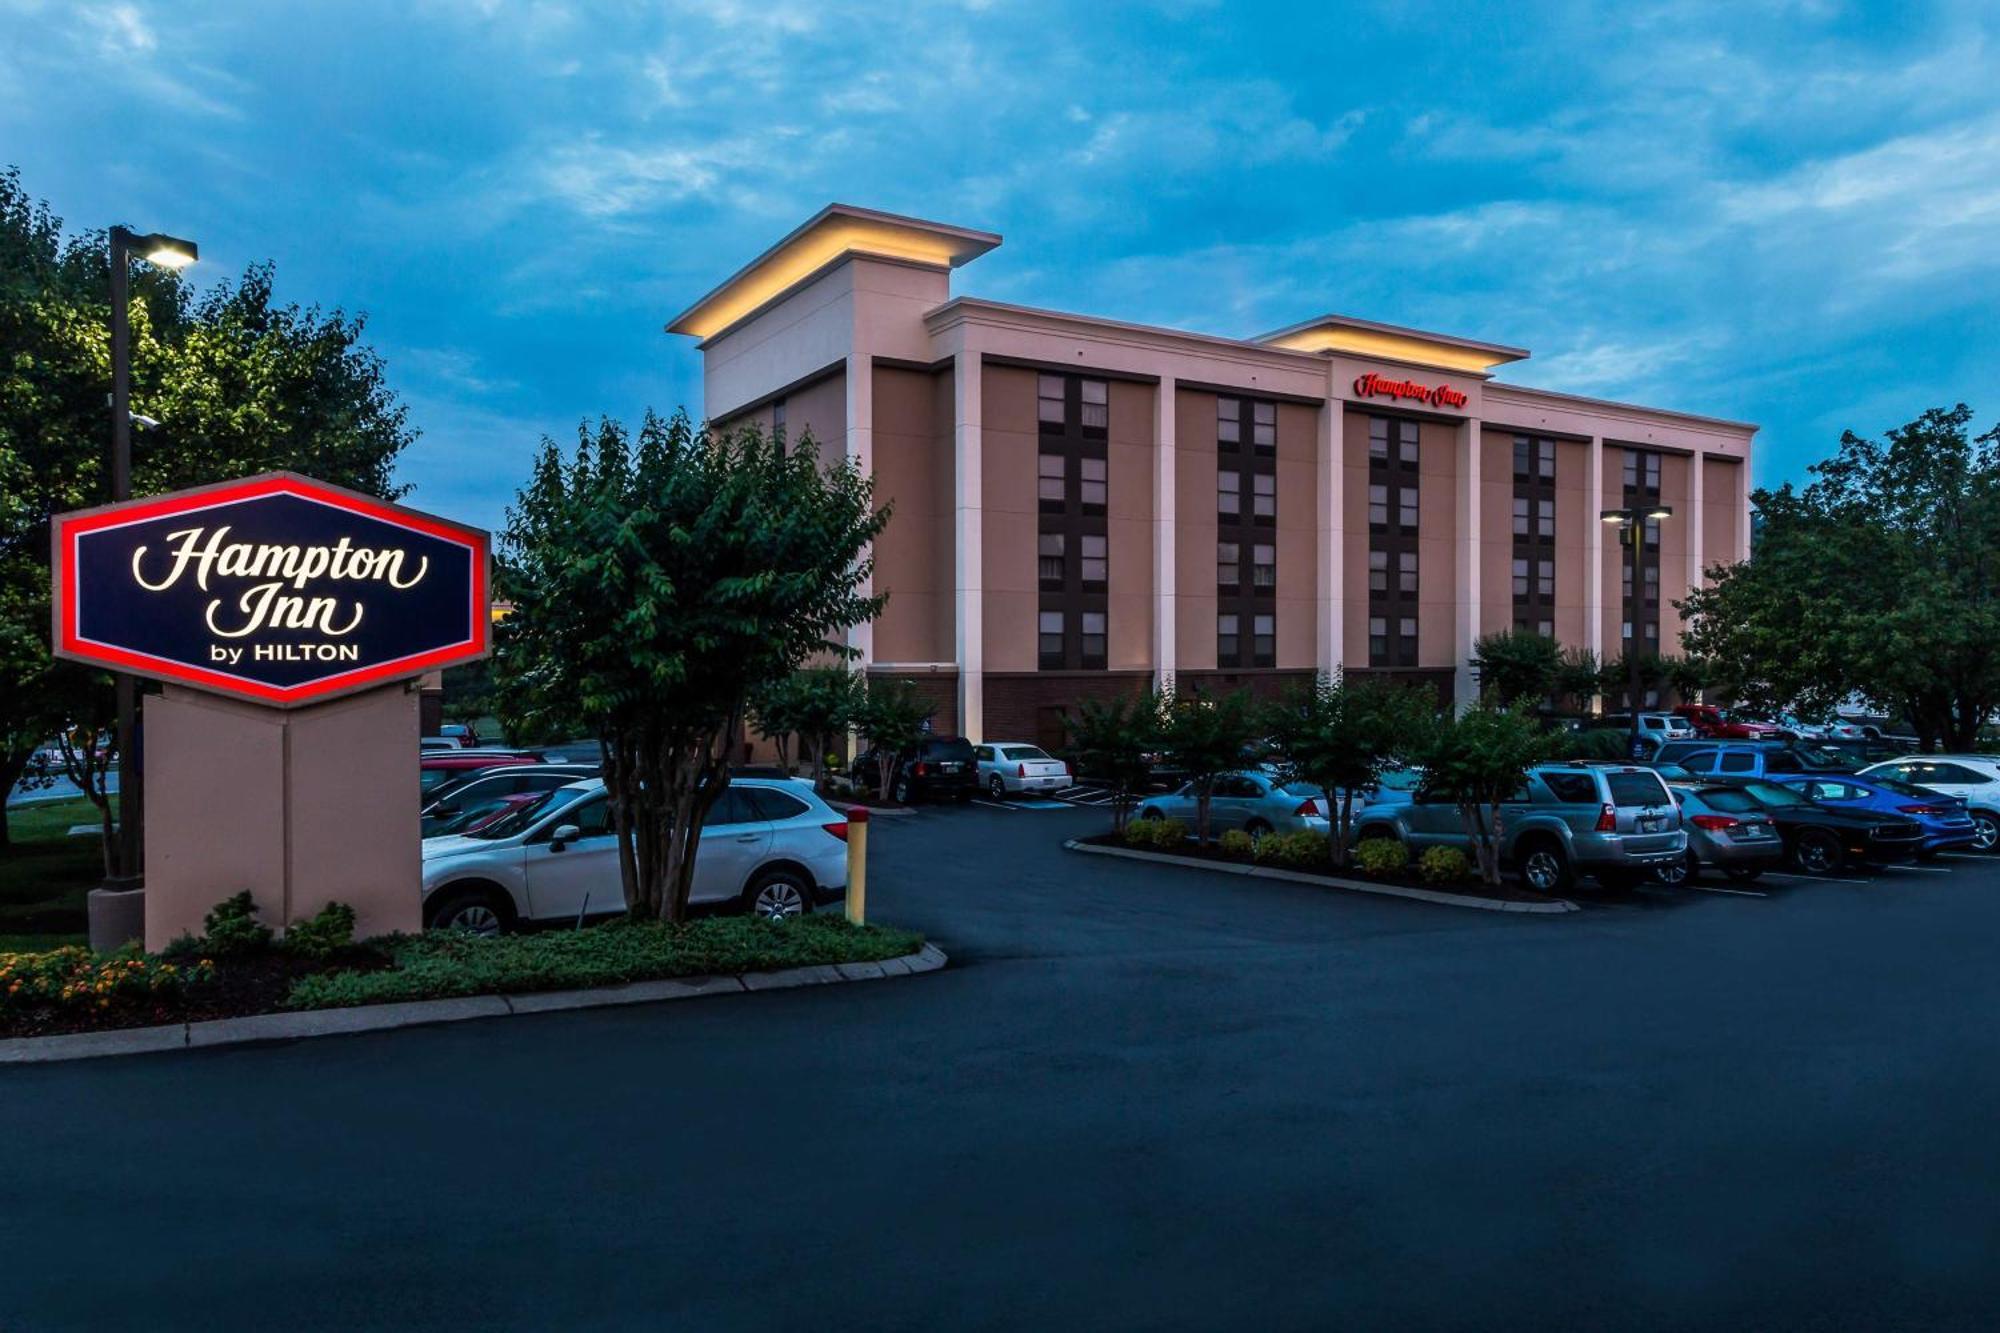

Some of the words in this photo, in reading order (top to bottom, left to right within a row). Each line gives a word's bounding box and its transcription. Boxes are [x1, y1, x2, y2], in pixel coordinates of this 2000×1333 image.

[1353, 373, 1431, 402] Hampton
[1431, 385, 1467, 408] Inn
[132, 525, 429, 592] Hampton
[205, 582, 364, 638] Inn
[210, 644, 243, 664] by
[254, 644, 359, 661] HILTON
